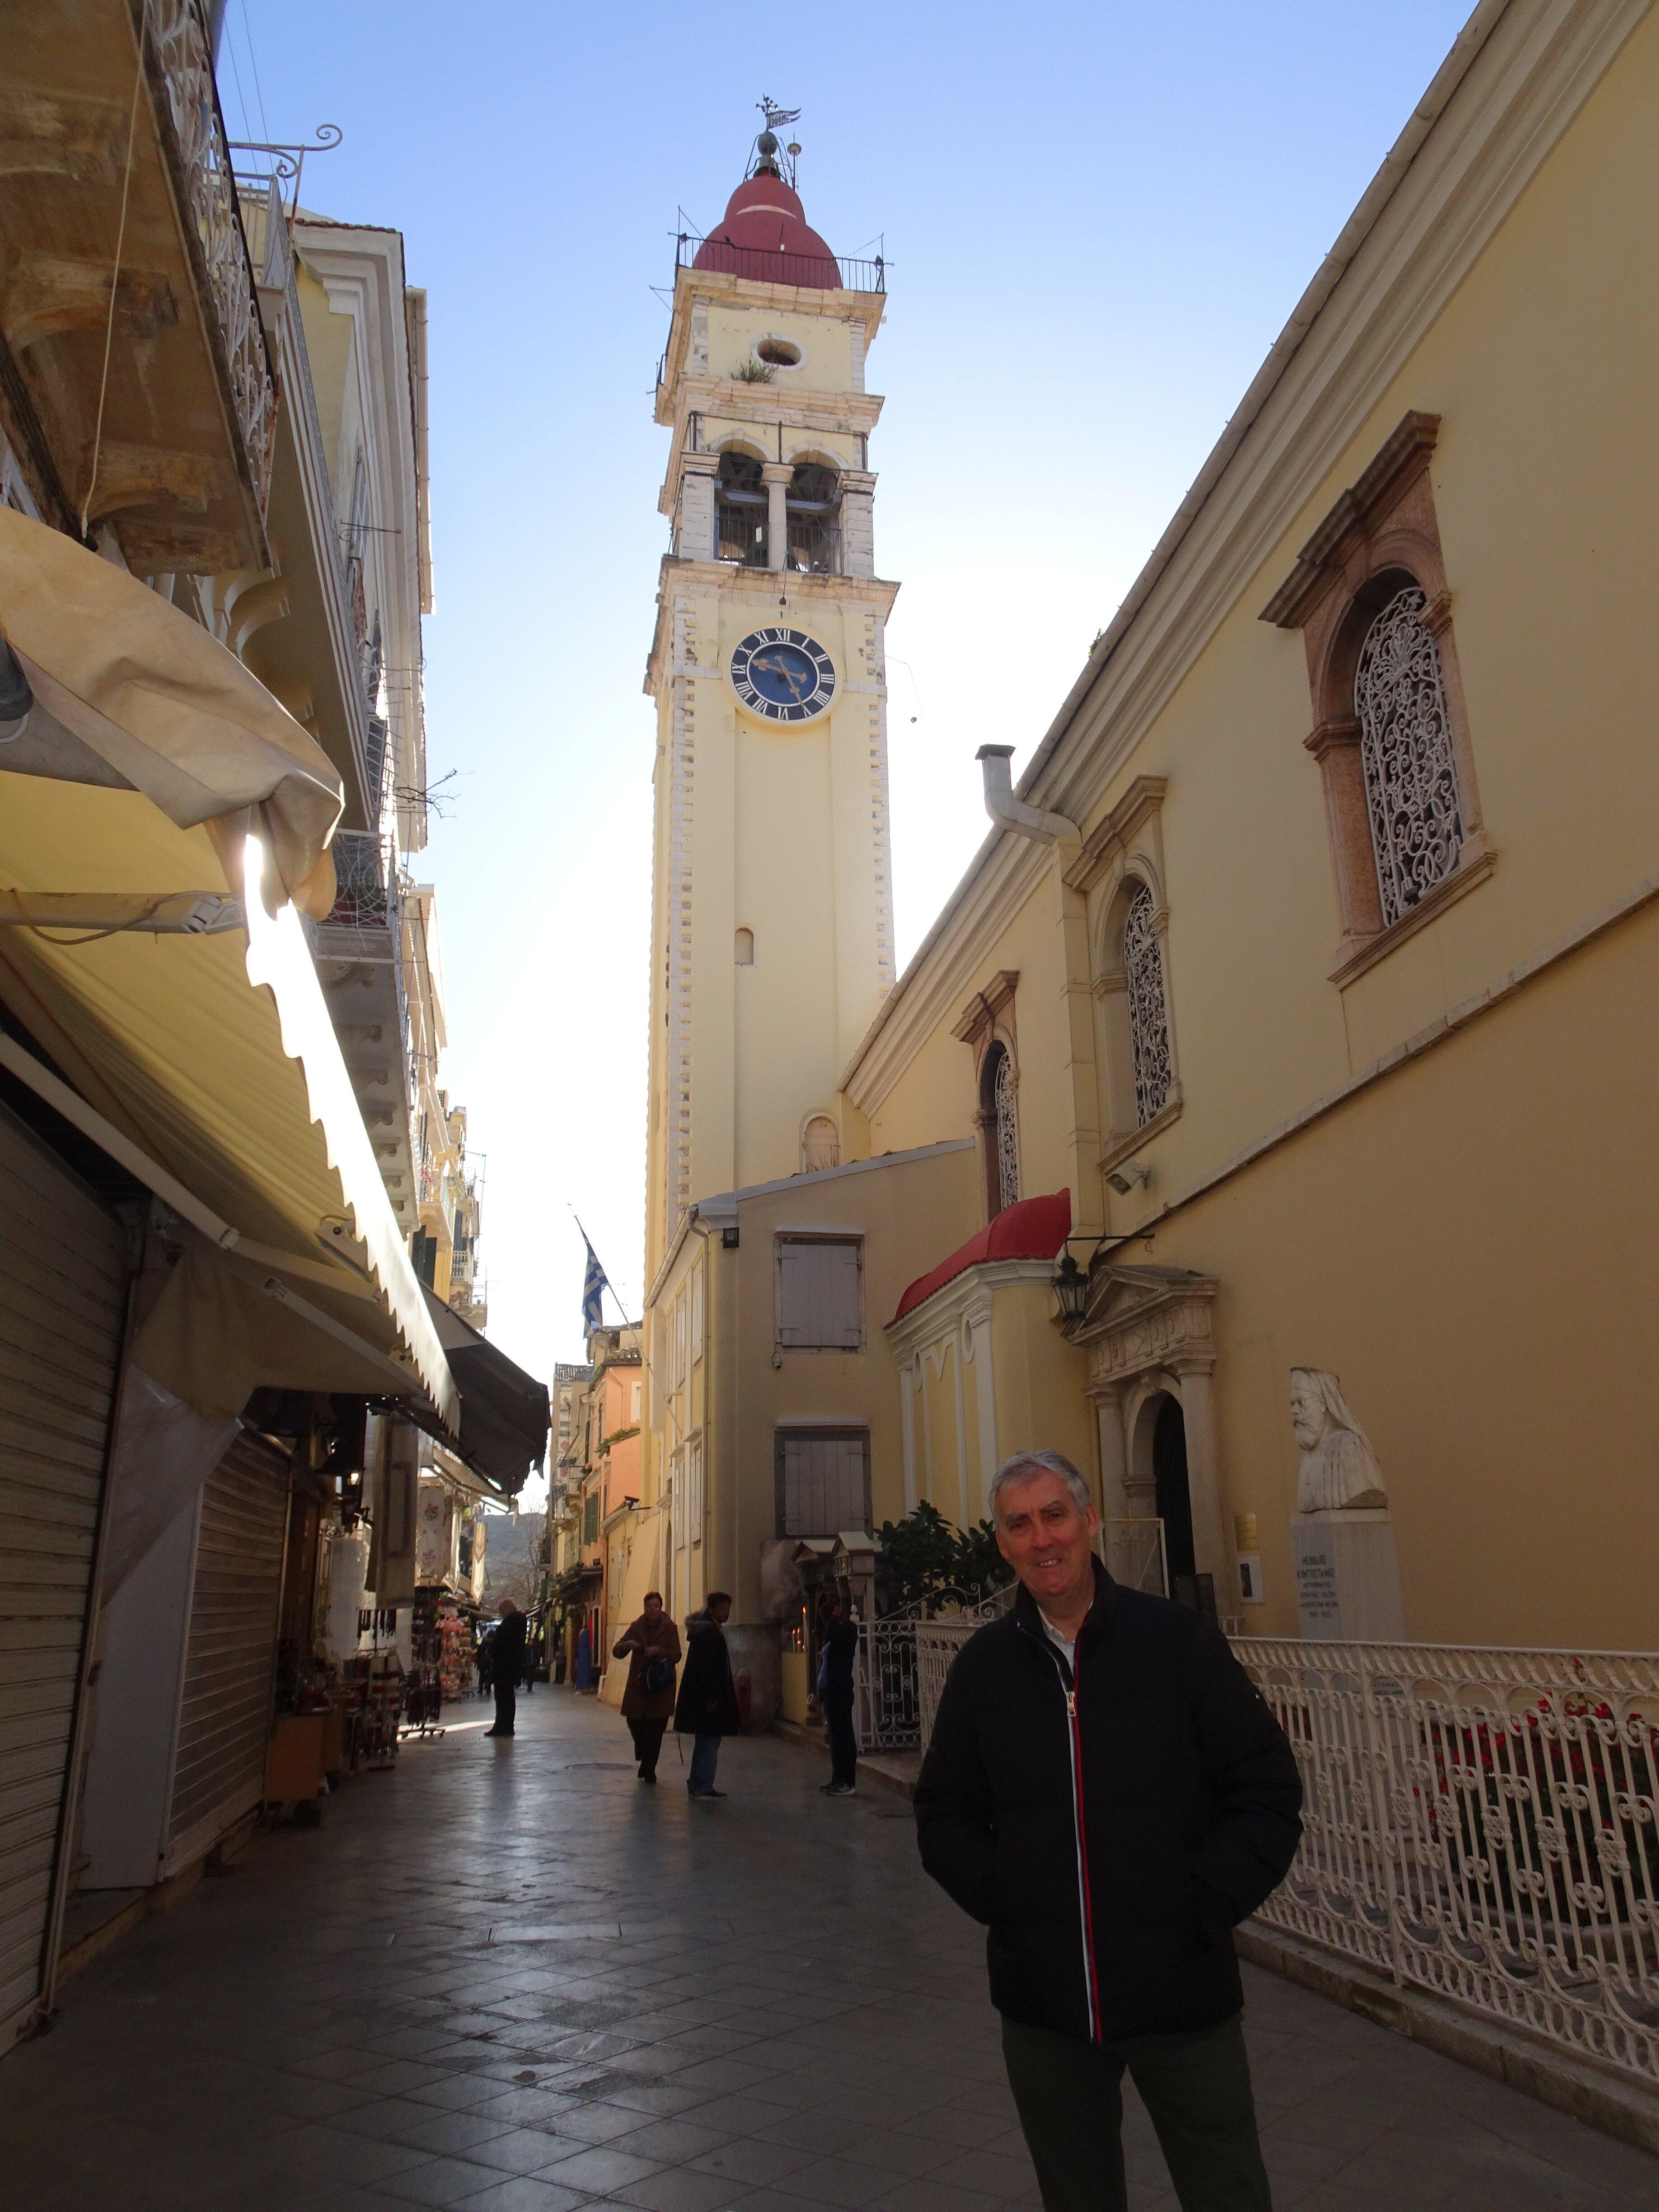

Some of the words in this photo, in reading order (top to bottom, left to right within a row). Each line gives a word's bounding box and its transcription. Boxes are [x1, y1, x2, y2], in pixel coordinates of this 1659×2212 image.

[754, 630, 769, 645] XI
[775, 628, 790, 642] XII
[801, 637, 810, 648] I
[738, 644, 752, 656] X
[814, 653, 829, 663] II
[731, 662, 746, 674] IX
[820, 674, 834, 684] III
[735, 681, 754, 700] VIII
[813, 690, 830, 706] IIII
[752, 698, 768, 714] VII
[778, 707, 789, 720] VI
